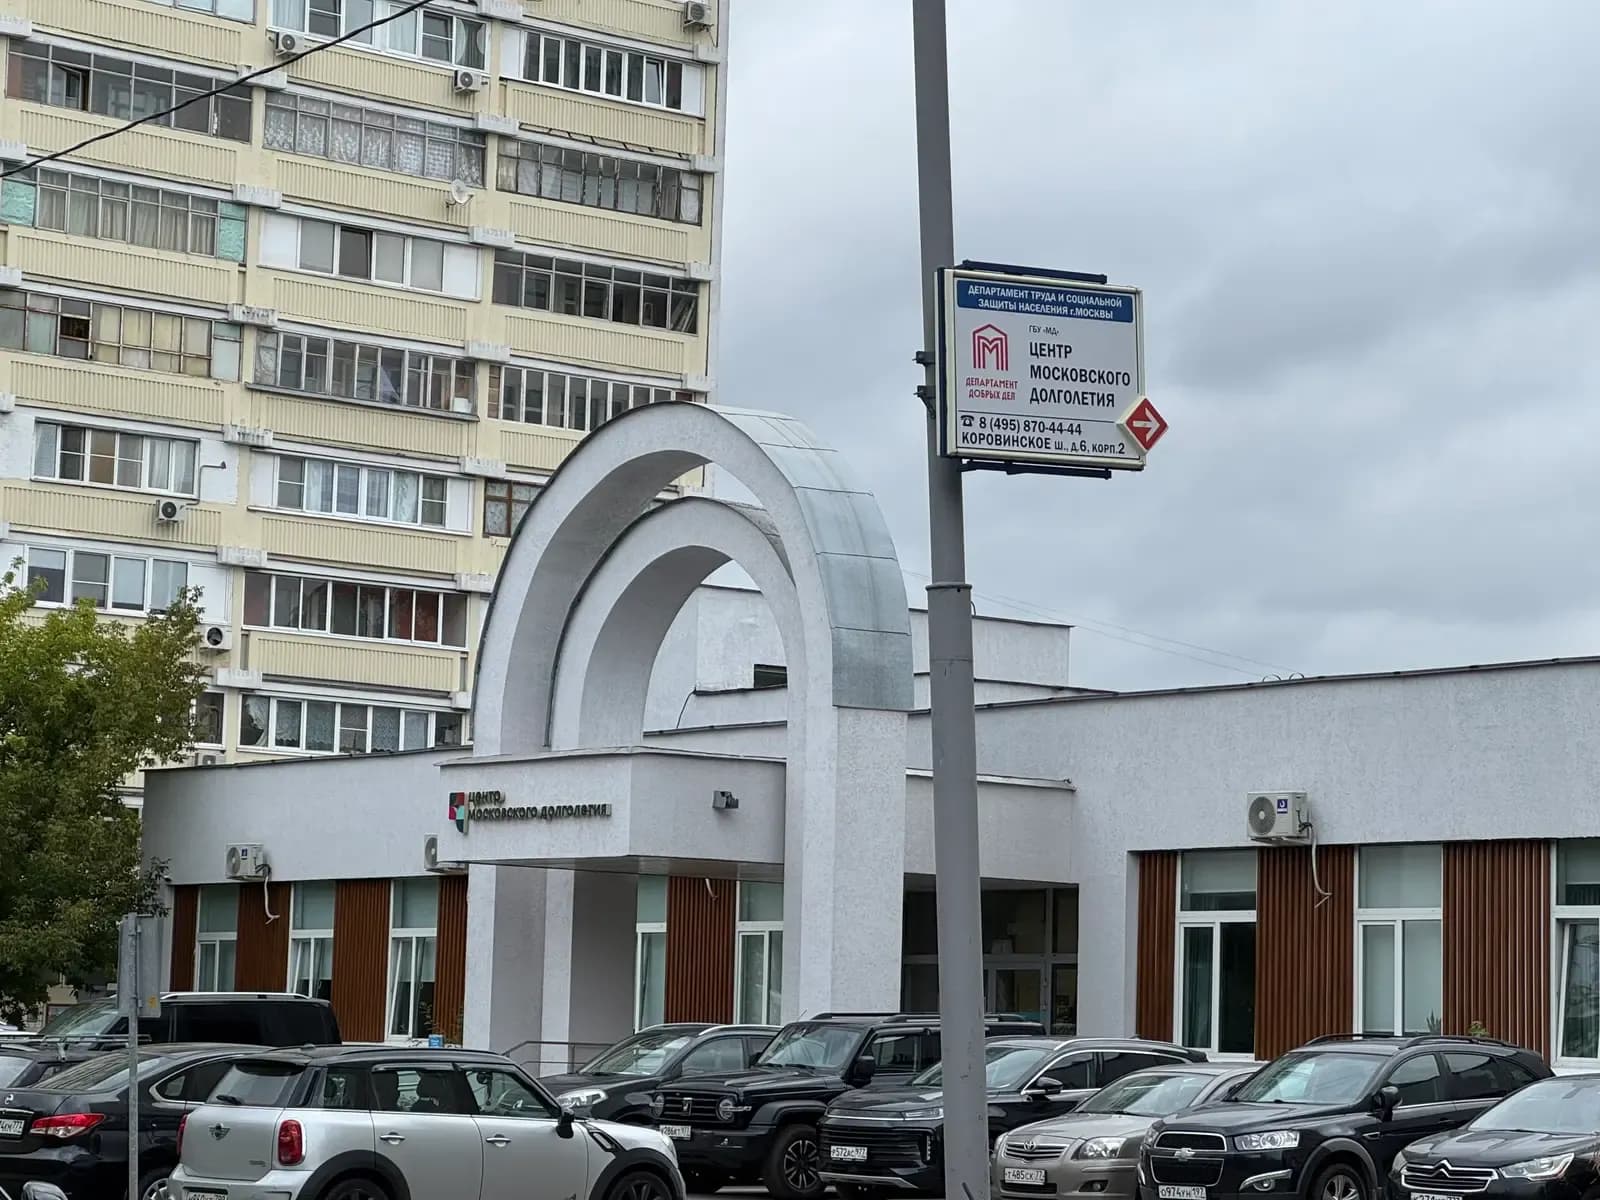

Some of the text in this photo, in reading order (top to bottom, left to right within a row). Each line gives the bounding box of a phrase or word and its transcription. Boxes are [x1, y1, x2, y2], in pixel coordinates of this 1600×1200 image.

[967, 285, 1122, 308] ДЕПАРТАМЕНТ ТРУДА И СОЦИАЛЬНОЙ
[978, 298, 1017, 311] ЗАЩИТЫ
[1018, 302, 1068, 316] НАСЕЛЕНИЯ
[1029, 325, 1041, 333] ГБУ
[1029, 342, 1073, 359] ЦЕНТР
[966, 377, 1018, 389] ДЕПАРТАМЕНТ
[1030, 364, 1131, 387] МОСКОВСКОГО
[969, 389, 1016, 400] ДОБРЫХ ДЕЛ
[1030, 387, 1115, 408] ДОЛГОЛЕТИЯ
[979, 416, 1082, 436] 8 (495) 870-44-44
[962, 432, 1051, 450] КОРОВИНСКОЕ
